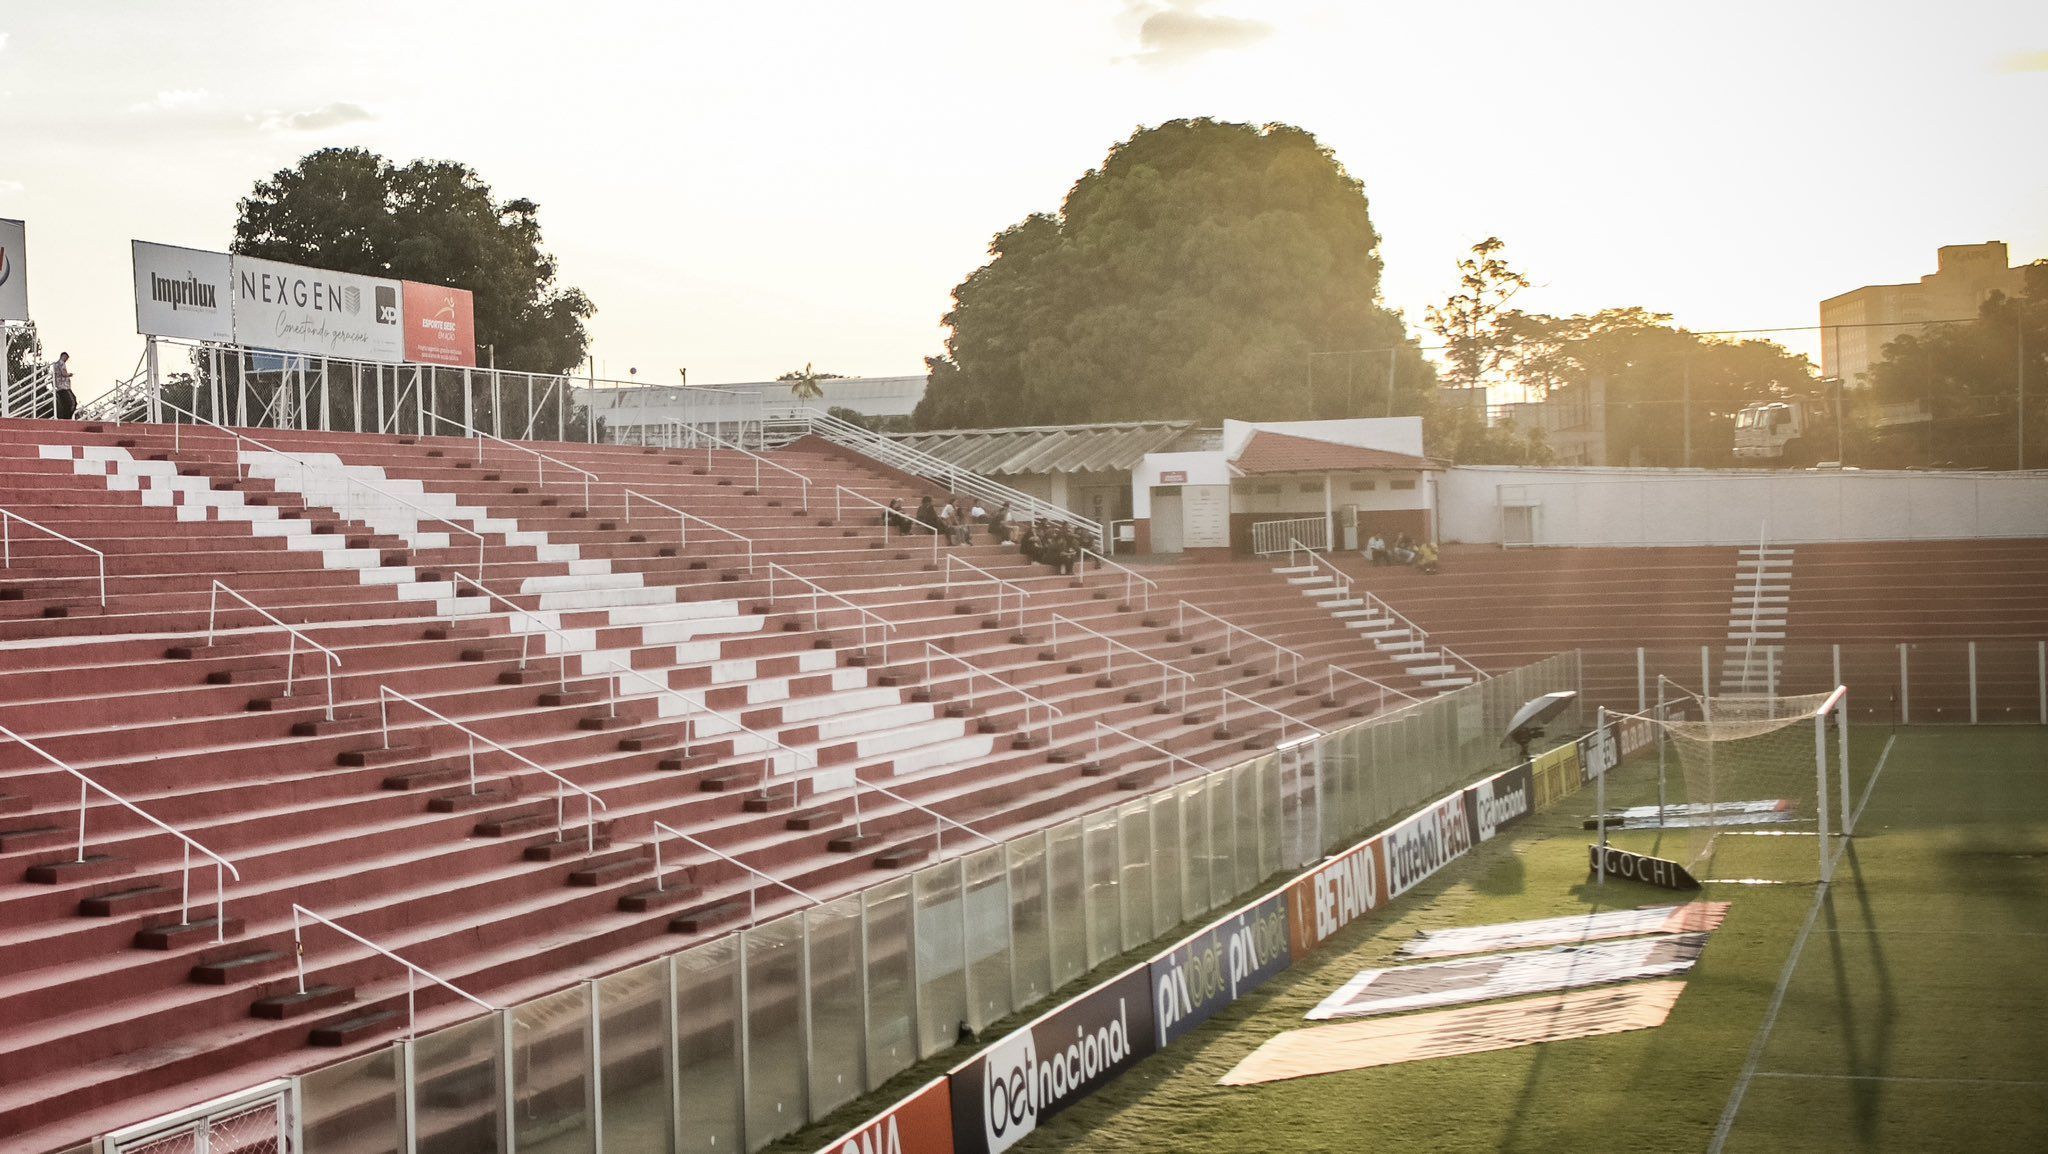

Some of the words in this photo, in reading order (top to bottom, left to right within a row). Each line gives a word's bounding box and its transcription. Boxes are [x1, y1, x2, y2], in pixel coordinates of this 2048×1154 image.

[151, 271, 216, 310] Imprilux
[241, 270, 342, 312] NEXGEN
[275, 309, 330, 343] Conectando
[1388, 813, 1440, 895] Futebol
[1314, 846, 1377, 941] BETANO
